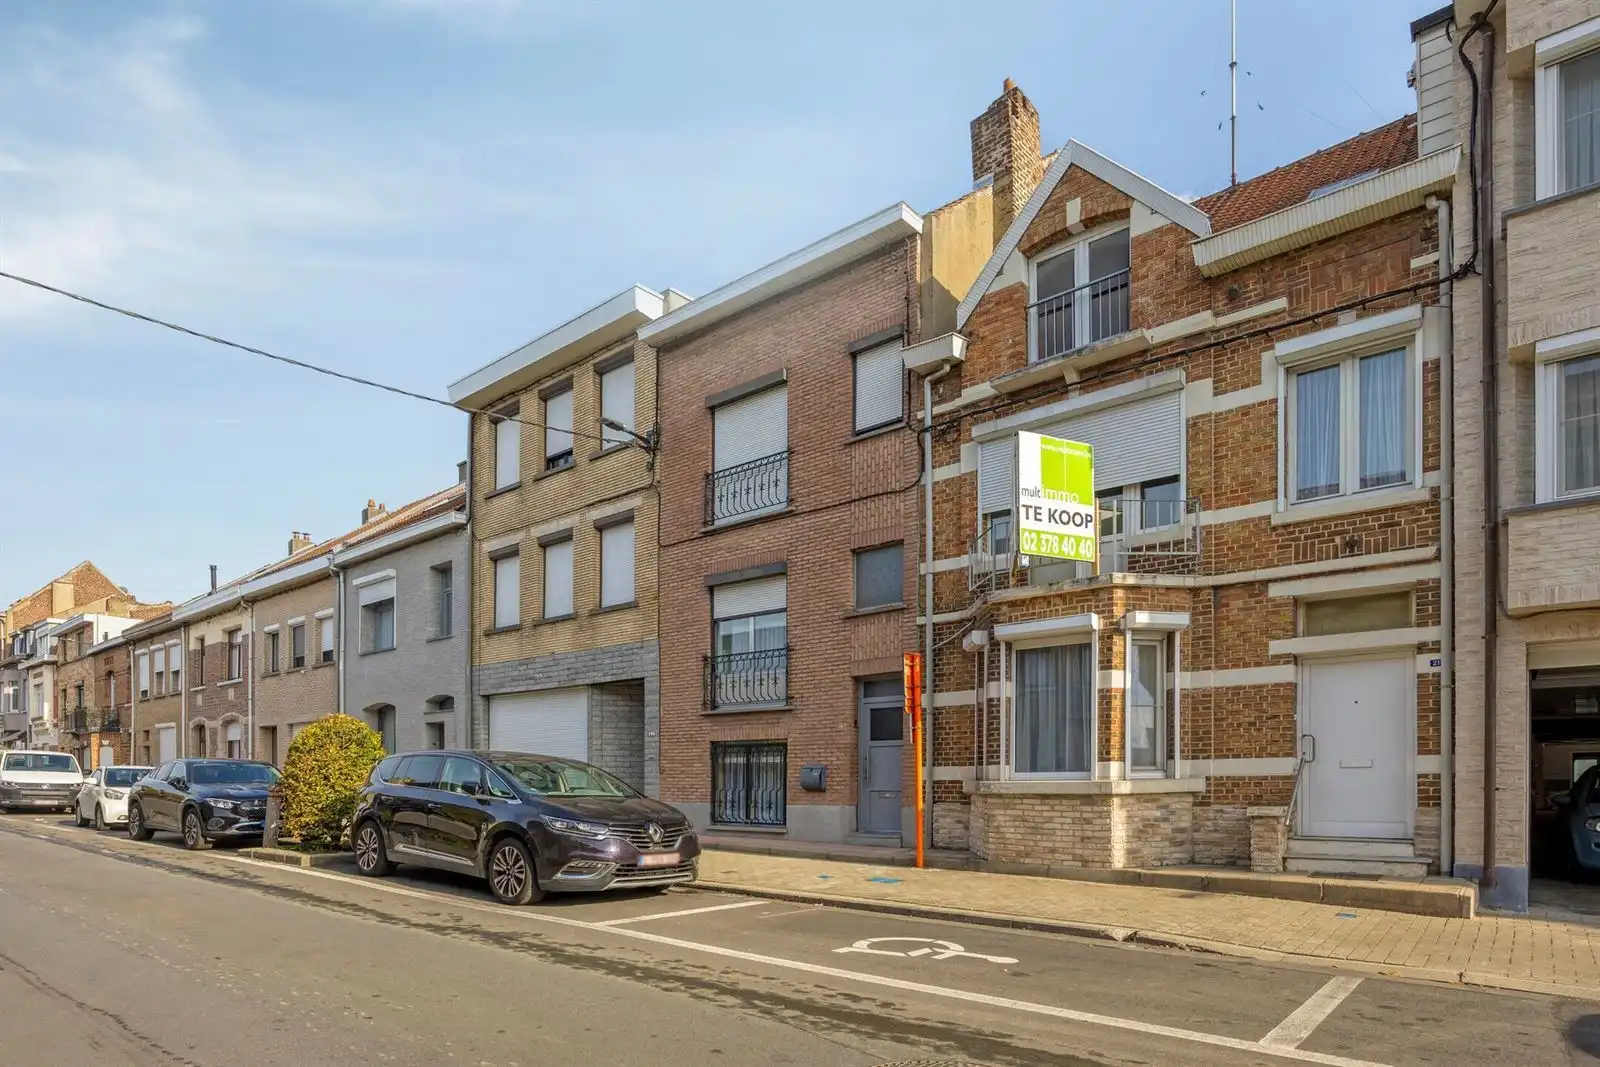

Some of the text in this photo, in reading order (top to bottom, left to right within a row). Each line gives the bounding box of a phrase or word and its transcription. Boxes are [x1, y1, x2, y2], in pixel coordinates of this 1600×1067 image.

[1021, 504, 1093, 529] TE KOOP
[1023, 530, 1093, 558] 02 378 40 40
